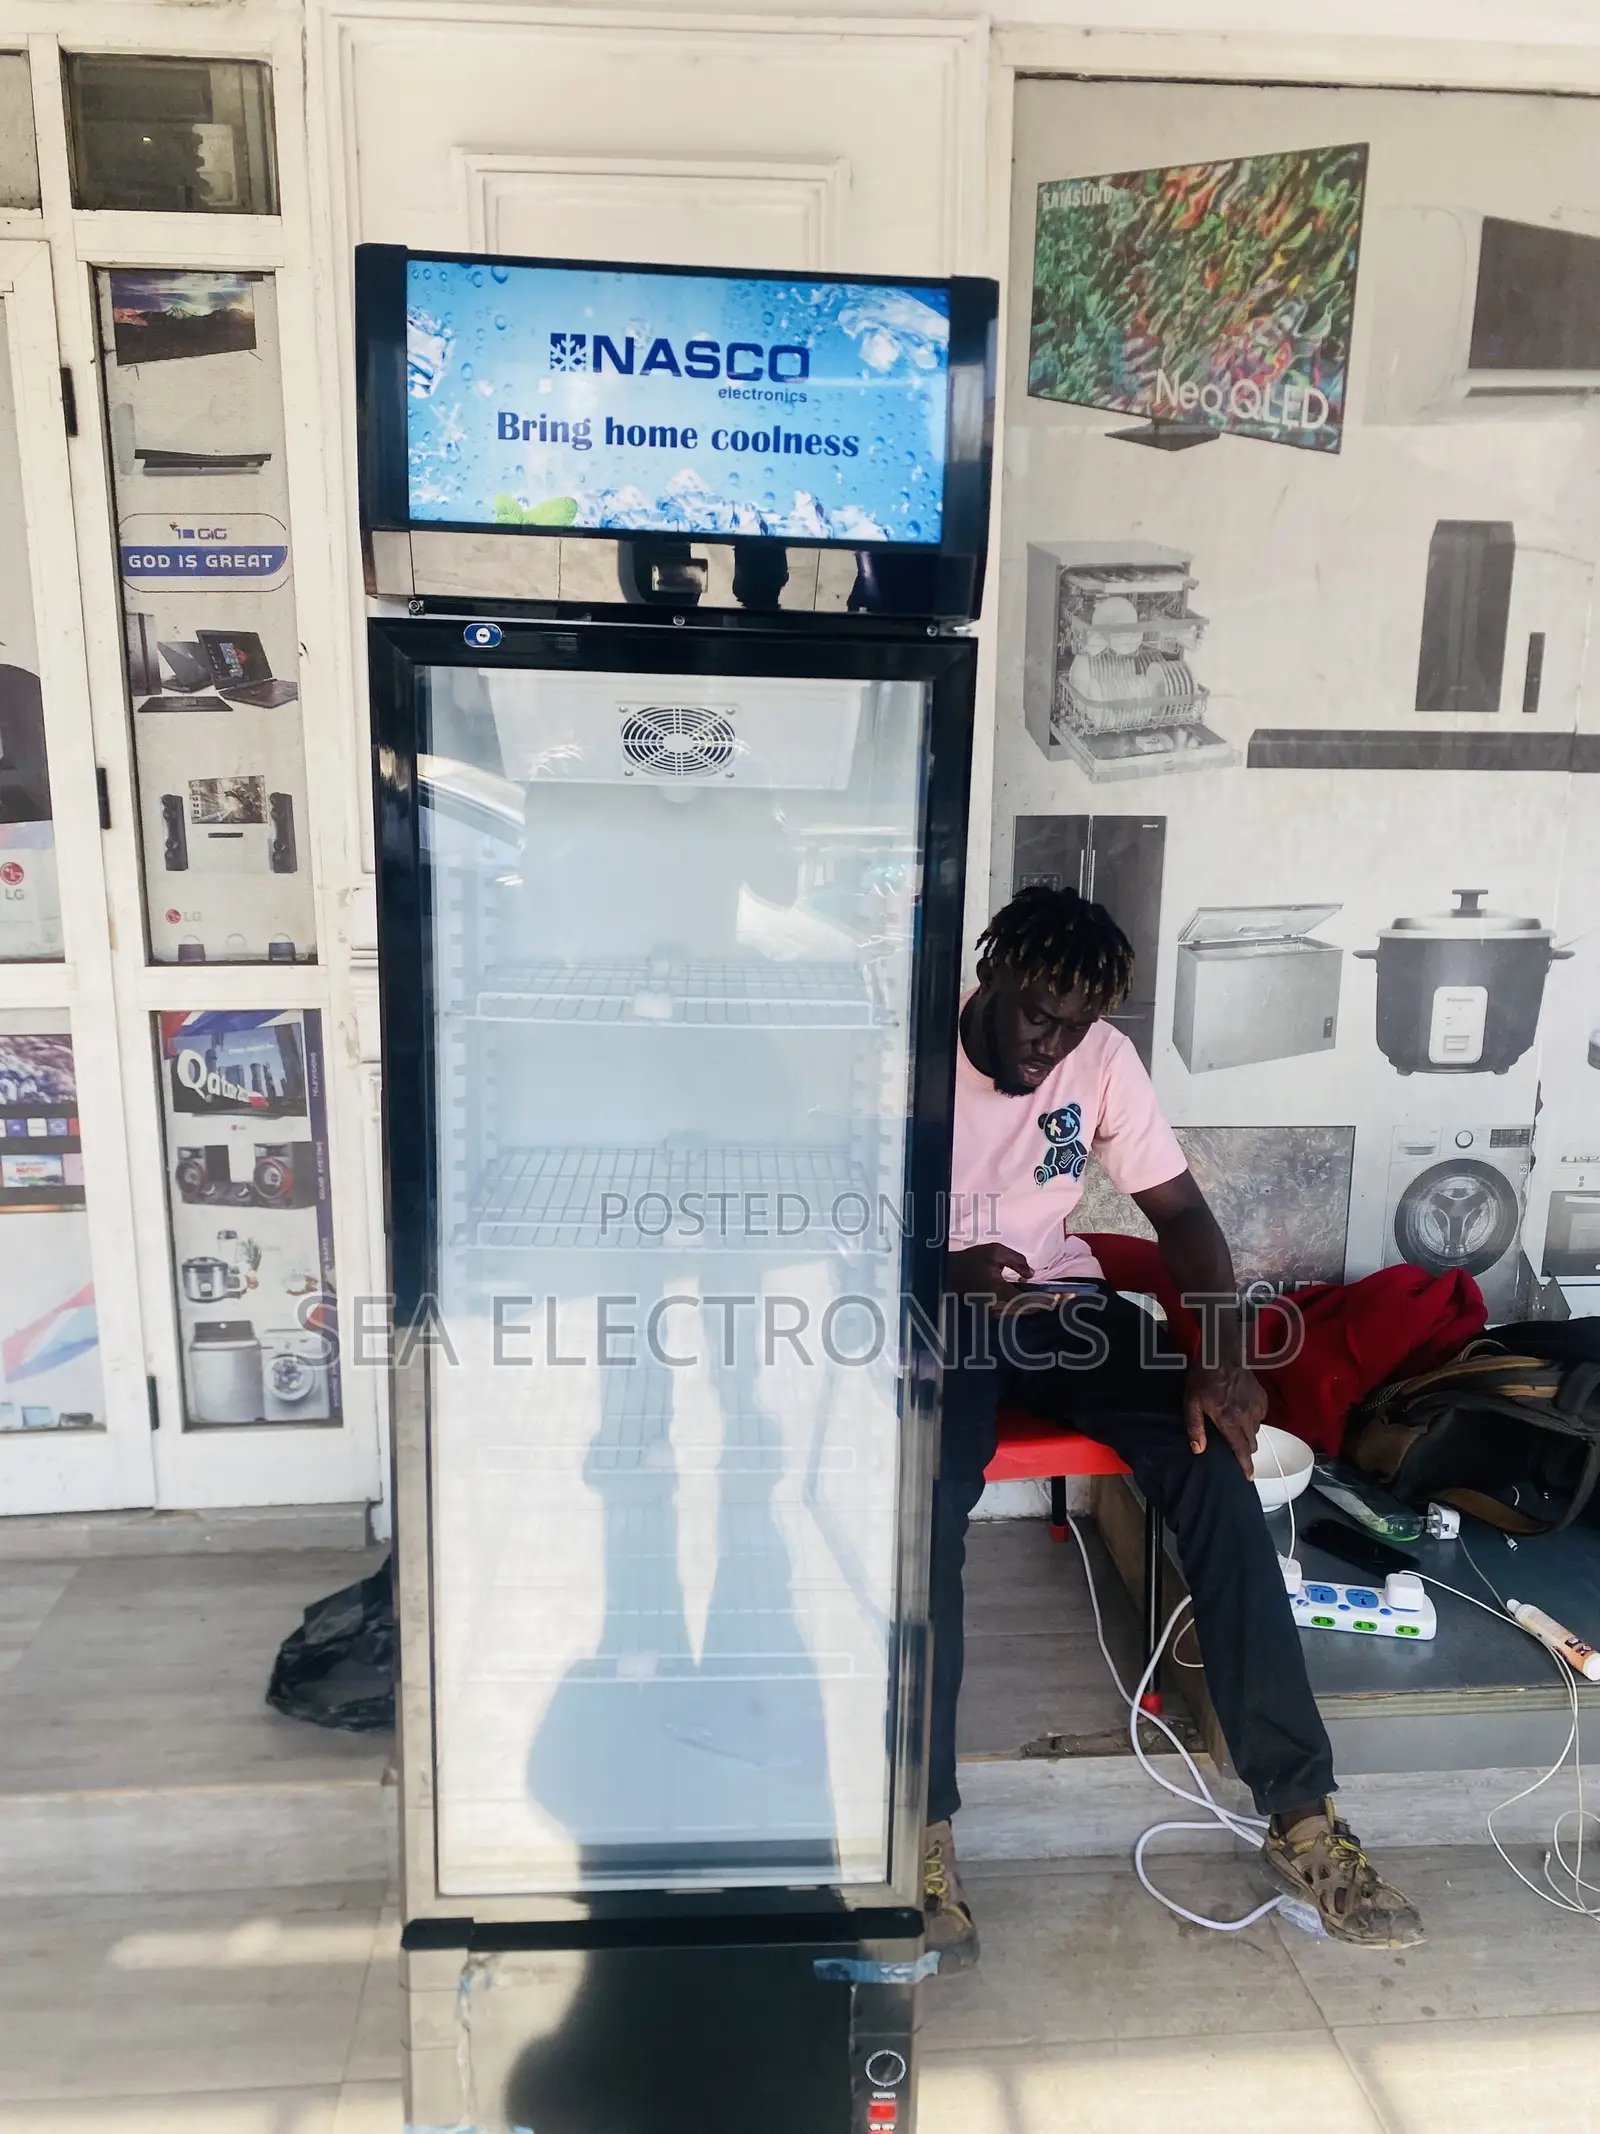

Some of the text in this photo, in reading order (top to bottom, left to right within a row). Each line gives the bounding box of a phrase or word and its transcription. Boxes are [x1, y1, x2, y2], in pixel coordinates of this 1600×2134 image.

[592, 334, 810, 383] NASCO
[718, 386, 808, 403] electronics
[1155, 368, 1329, 429] Neo QLED
[497, 411, 860, 458] Bring home coolness
[128, 554, 273, 569] GOD IS GREAT
[5, 888, 25, 901] LG
